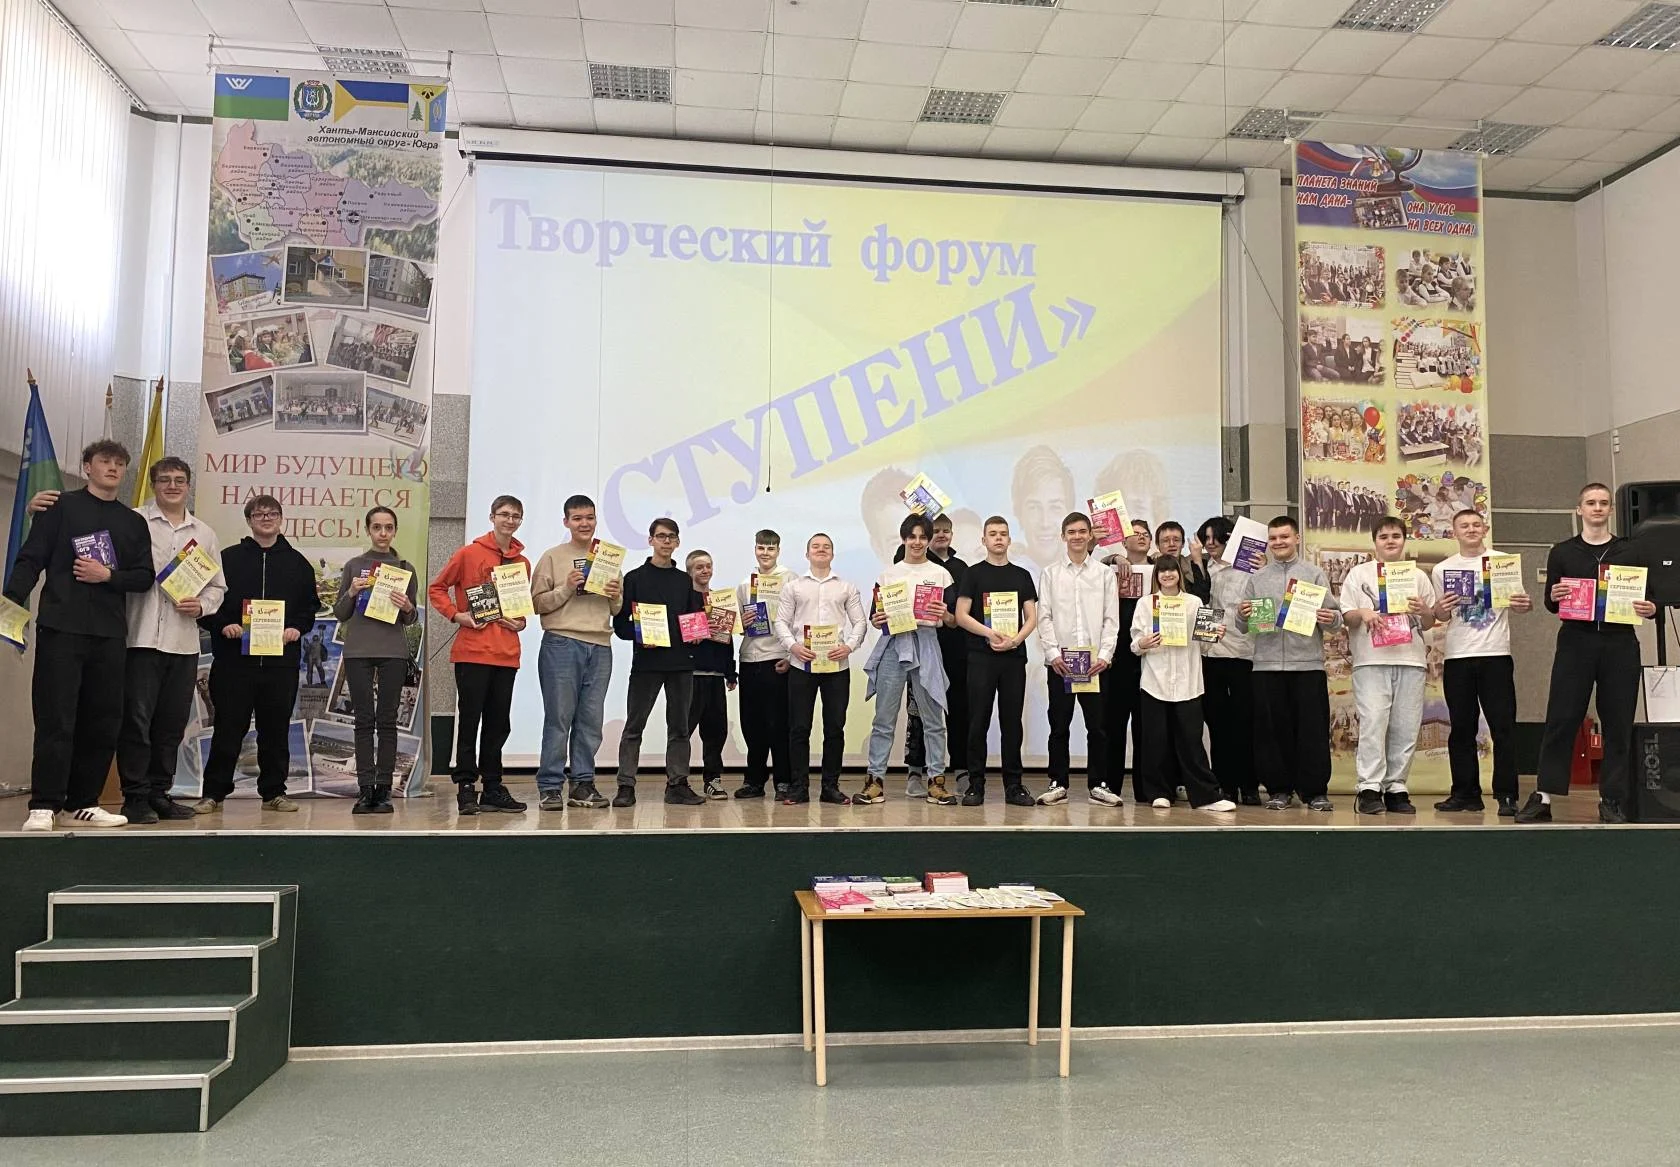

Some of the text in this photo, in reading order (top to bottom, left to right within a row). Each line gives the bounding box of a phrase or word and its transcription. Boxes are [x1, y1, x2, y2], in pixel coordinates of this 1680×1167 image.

[307, 135, 374, 146] автономный
[318, 125, 419, 139] Ханты-Мансийский
[1296, 174, 1378, 192] ПЛАНЕТА ЗНАНИЙ
[1296, 192, 1318, 206] НАМ
[1407, 201, 1456, 216] ОНА У НАС
[1407, 219, 1475, 236] НА ВСЕХ ОДНА!
[488, 198, 1037, 286] Творческий форум
[205, 453, 428, 481] МИР БУДУЩЕГО
[220, 485, 412, 509] НАЧИНАЕТСЯ
[283, 518, 361, 541] ДЕСЬ!
[1644, 733, 1661, 790] PROEL
